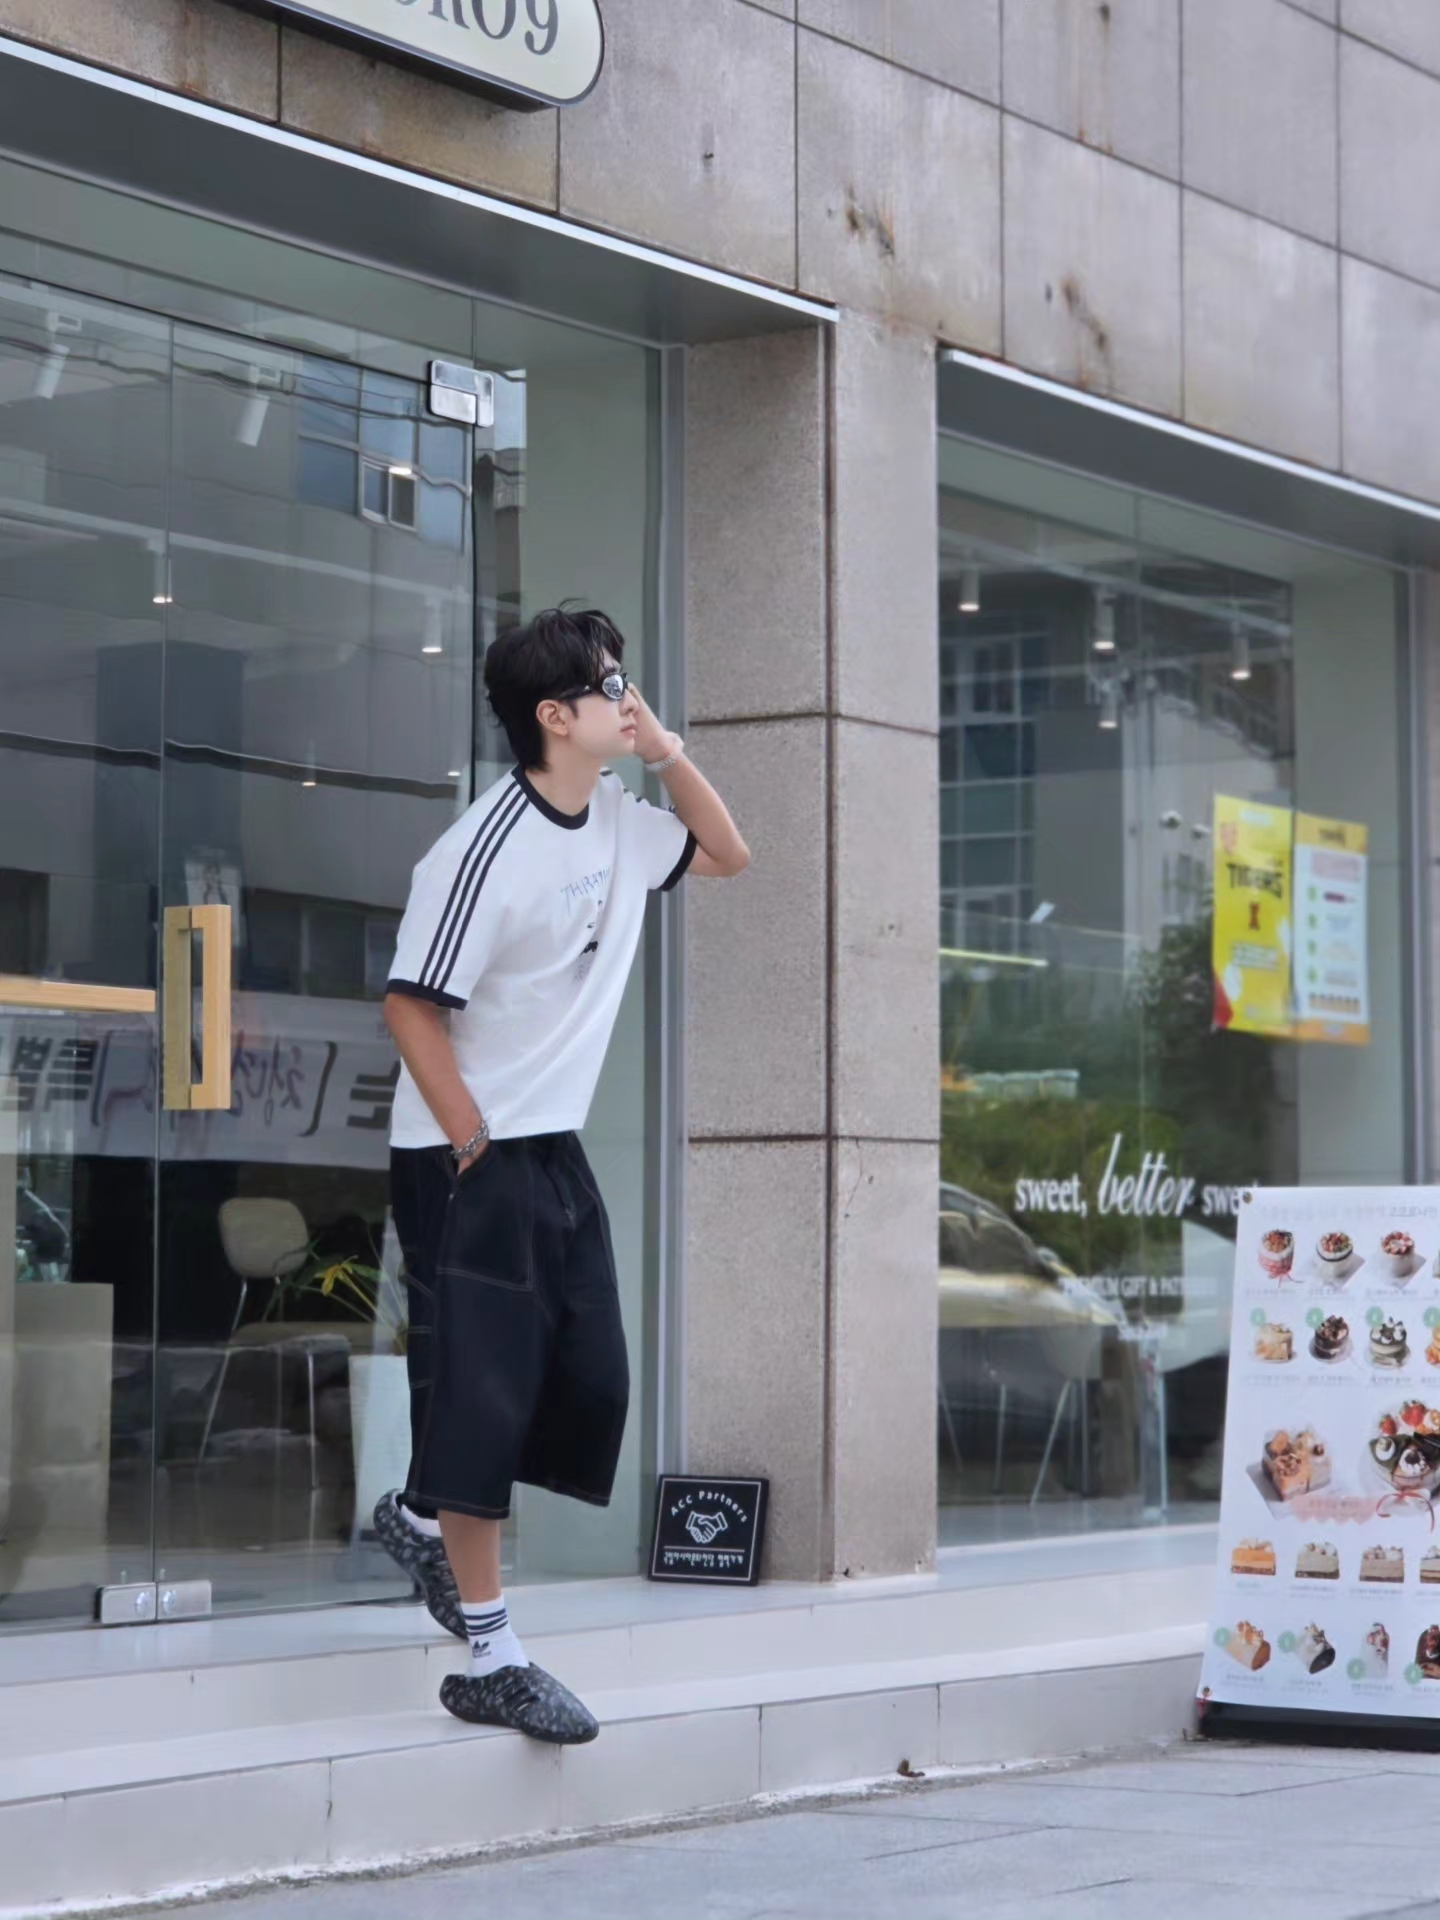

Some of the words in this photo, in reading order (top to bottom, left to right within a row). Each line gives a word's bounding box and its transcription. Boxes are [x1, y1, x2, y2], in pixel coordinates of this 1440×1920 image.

[1015, 1173, 1087, 1218] sweet,
[1098, 1132, 1196, 1217] better
[1202, 1182, 1243, 1217] swe
[671, 1495, 692, 1517] ACC
[699, 1491, 747, 1522] Partners
